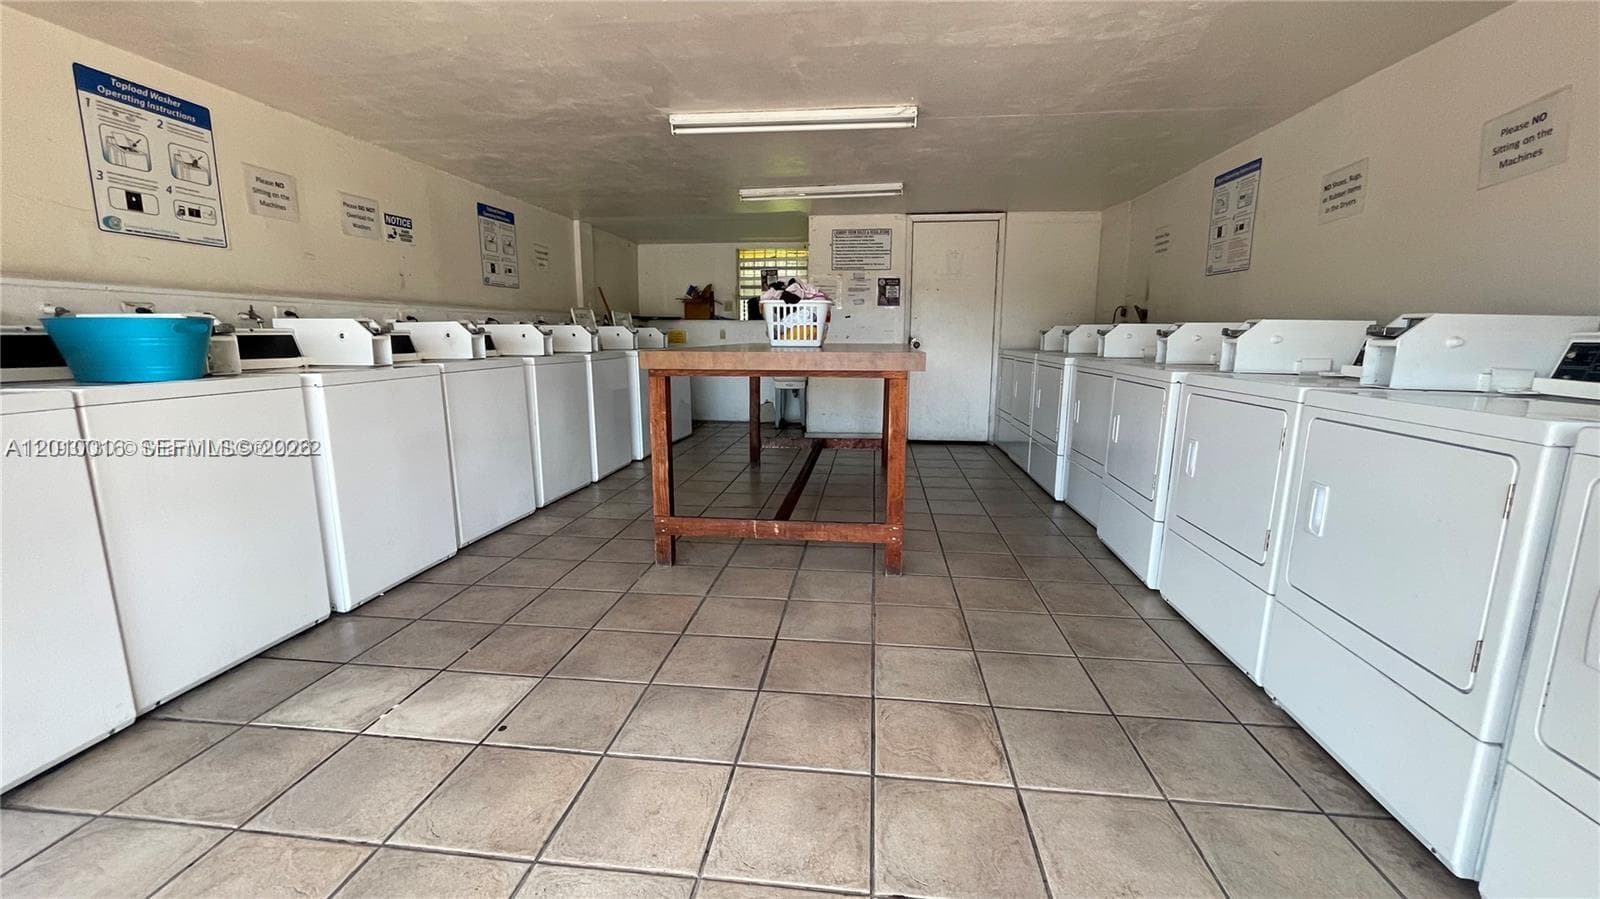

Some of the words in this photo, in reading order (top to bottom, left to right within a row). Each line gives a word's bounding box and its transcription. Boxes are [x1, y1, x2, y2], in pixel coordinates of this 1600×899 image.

[111, 77, 148, 97] Topload
[150, 90, 181, 108] Washer
[85, 97, 90, 107] 1
[97, 84, 145, 108] Operating
[147, 101, 196, 122] Instructions
[157, 119, 163, 129] 2
[1500, 121, 1530, 137] Please
[1531, 112, 1548, 125] NO
[1492, 140, 1520, 156] Sitting
[1522, 135, 1535, 145] on
[1537, 128, 1553, 140] the
[1499, 148, 1543, 169] Machines
[96, 170, 104, 180] 3
[256, 176, 274, 186] Please
[275, 181, 285, 189] NO
[166, 186, 172, 194] 4
[260, 199, 286, 210] Machines
[385, 214, 411, 228] NOTICE
